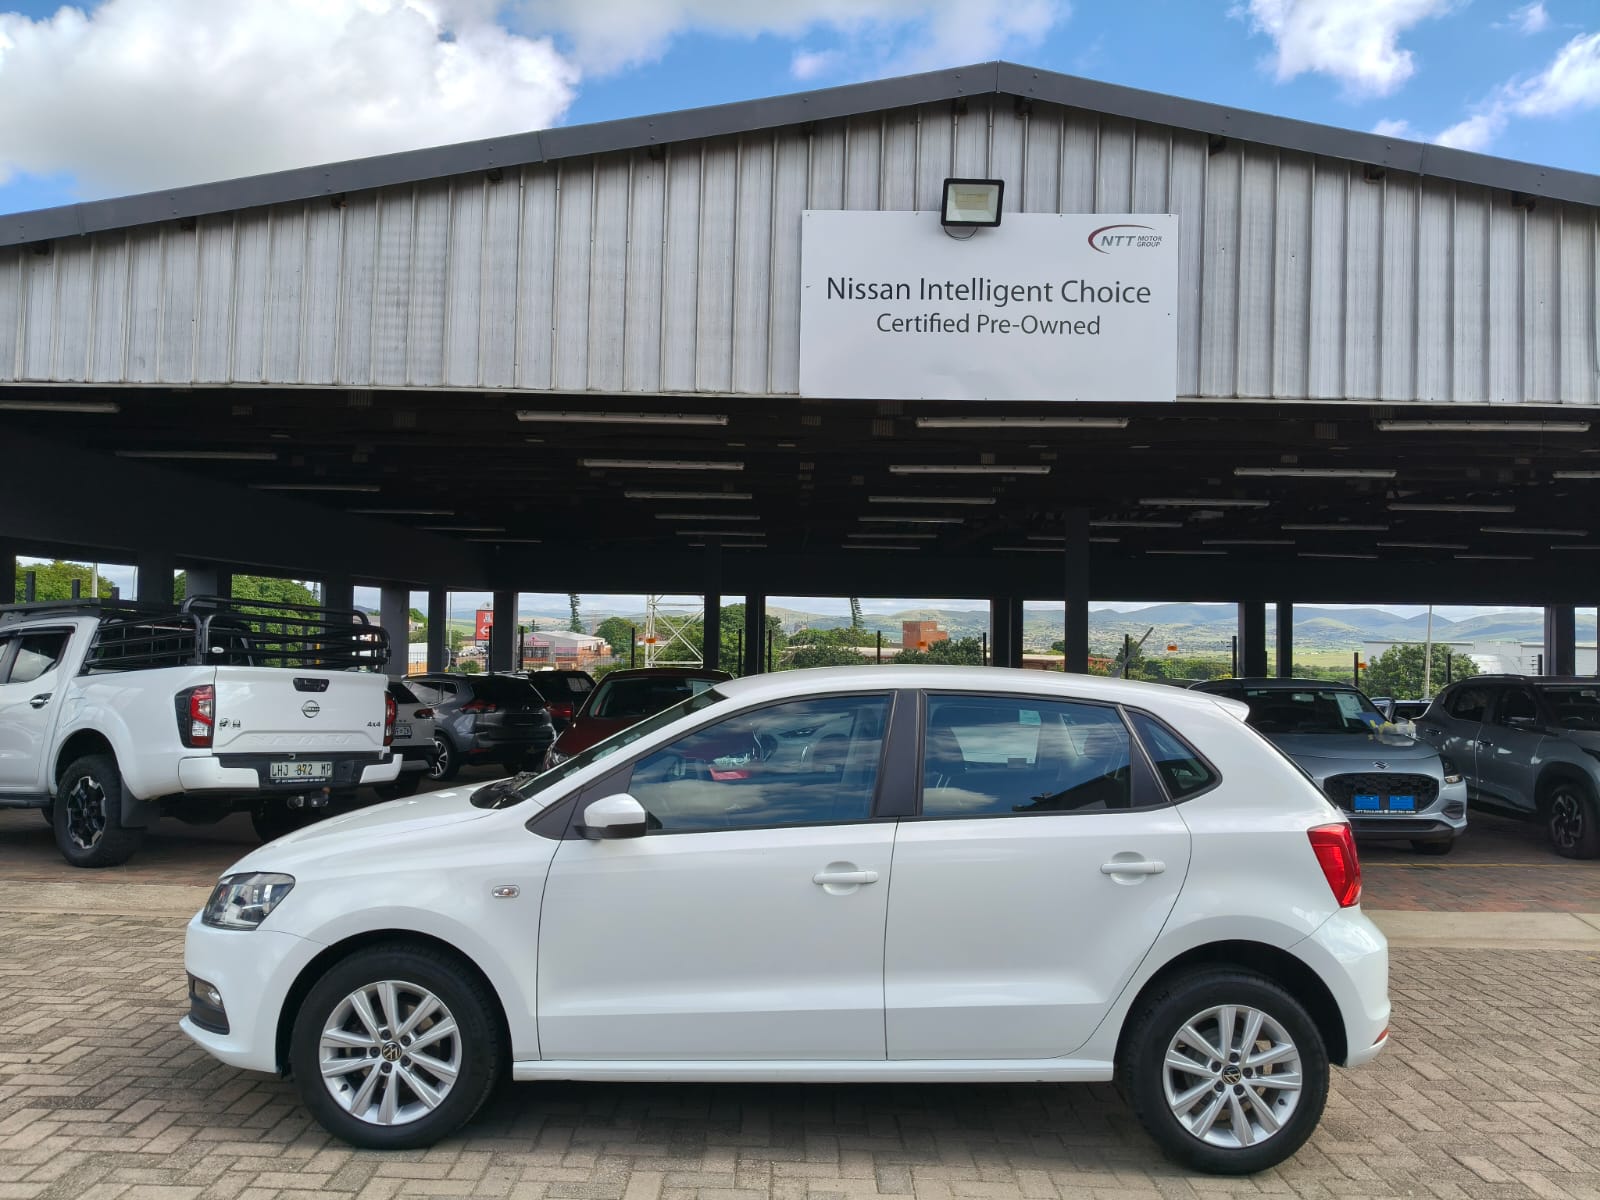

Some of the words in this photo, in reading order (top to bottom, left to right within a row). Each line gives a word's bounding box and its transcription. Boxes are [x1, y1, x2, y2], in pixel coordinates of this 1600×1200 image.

[1101, 235, 1136, 247] NTT
[827, 277, 911, 300] Nissan
[920, 277, 1054, 308] Intelligent
[1061, 279, 1151, 304] Choice
[876, 312, 970, 333] Certified
[977, 314, 1101, 335] Pre-Owned
